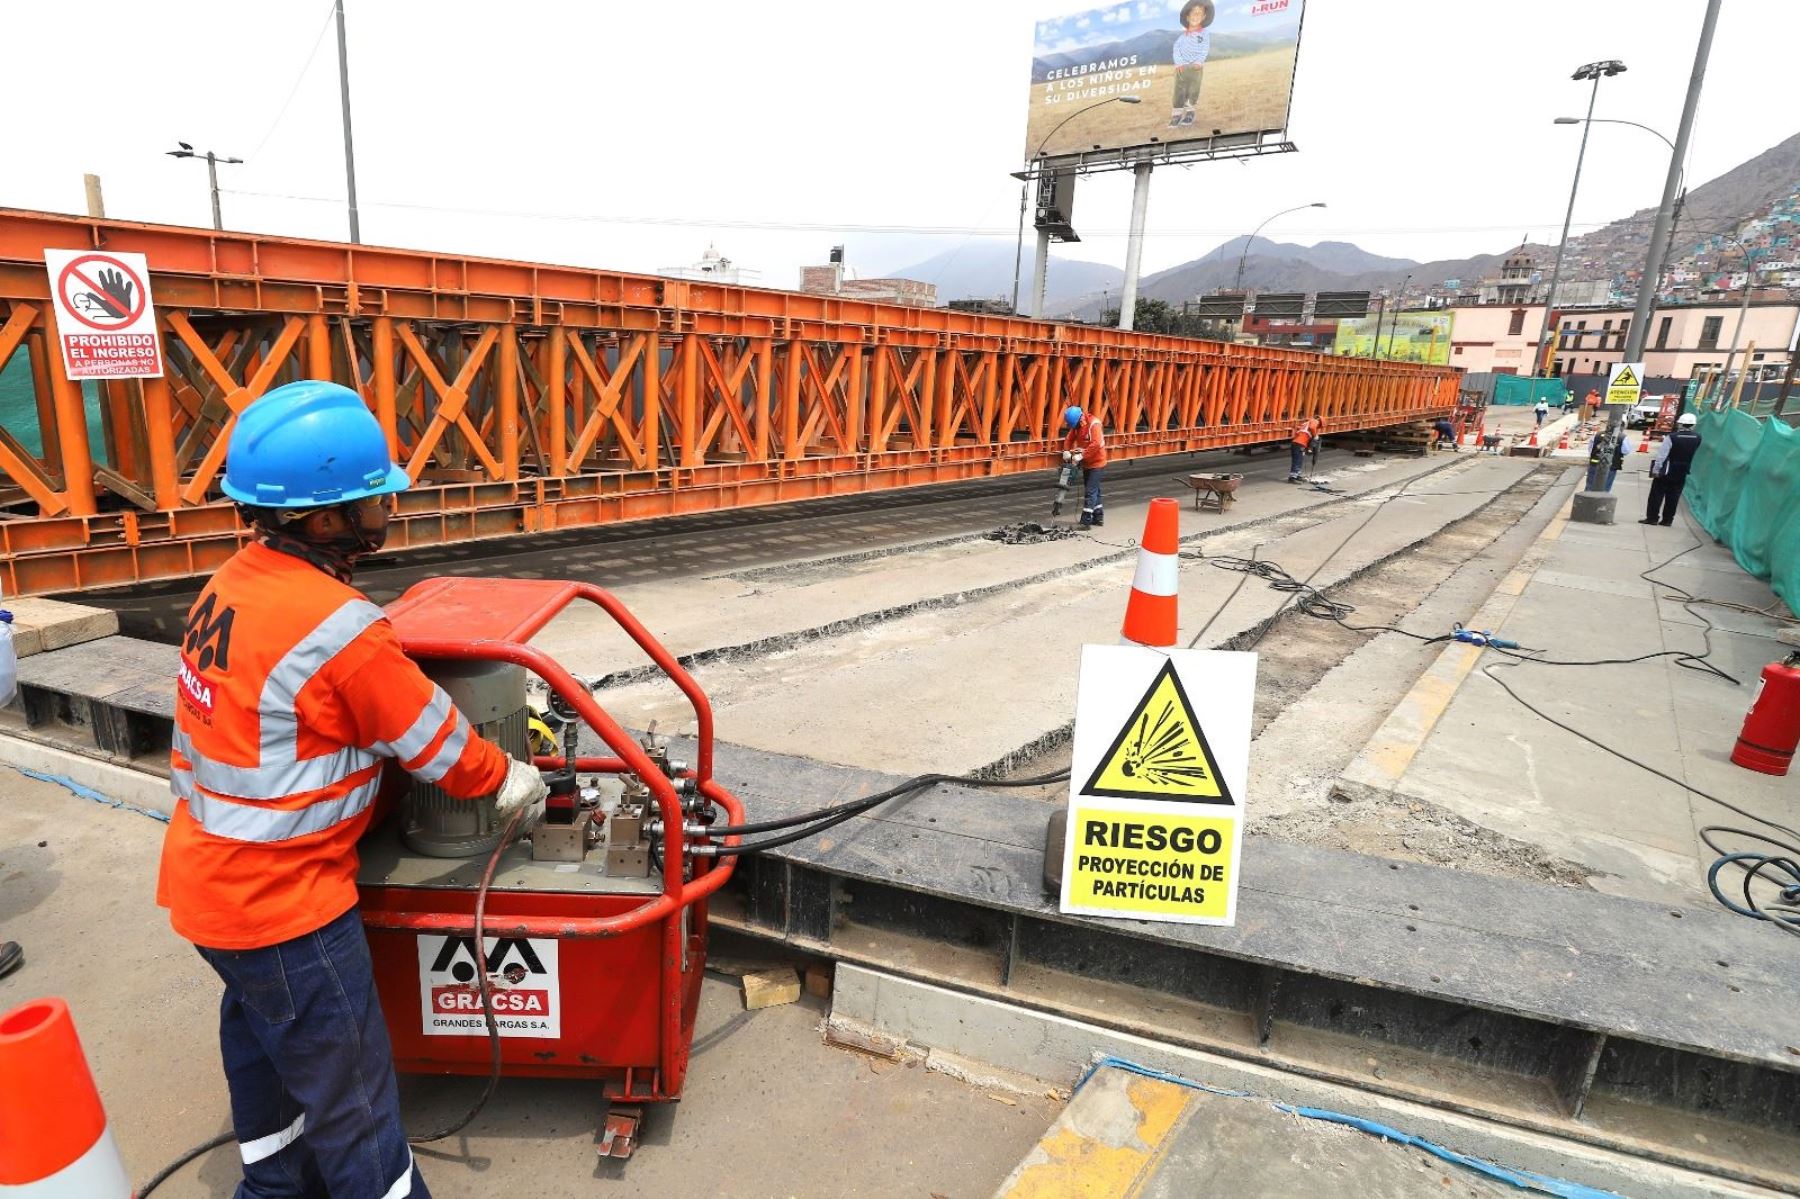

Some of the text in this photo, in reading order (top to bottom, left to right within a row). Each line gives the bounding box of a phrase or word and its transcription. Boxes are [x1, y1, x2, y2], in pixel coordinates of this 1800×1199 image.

[1046, 65, 1157, 93] A LOS NIÑOS EN
[1047, 55, 1137, 81] CELEBRAMOS
[1045, 80, 1152, 104] SU DIVERSIDAD
[69, 335, 153, 347] PROHIBIDO
[71, 348, 154, 358] EL INGRESO
[81, 366, 151, 374] AUTORIZADAS
[1084, 820, 1222, 854] RIESGO
[1078, 855, 1224, 881] PROYECCIÓN DE
[1093, 879, 1205, 903] PARTÍCULAS
[433, 1019, 550, 1029] GRANDES RGAS S.A.
